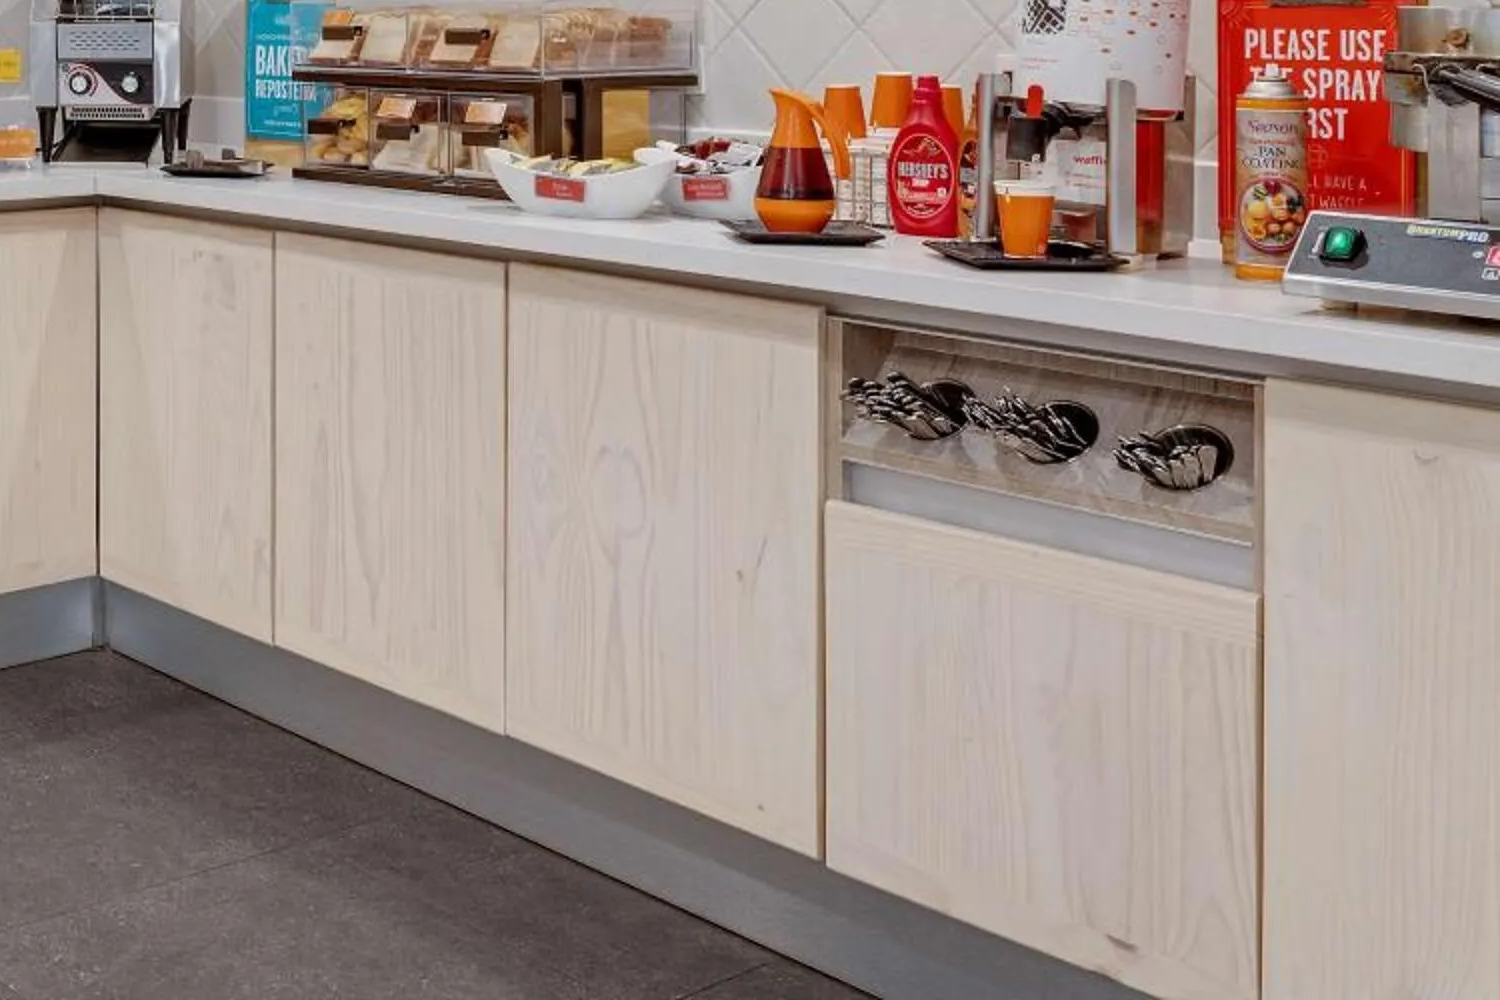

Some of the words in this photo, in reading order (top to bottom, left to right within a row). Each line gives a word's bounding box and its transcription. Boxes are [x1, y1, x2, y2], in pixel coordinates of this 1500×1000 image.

[1244, 27, 1332, 61] PLEASE
[1339, 28, 1387, 62] USE
[1302, 67, 1381, 102] SPRAY
[1307, 107, 1349, 140] RST
